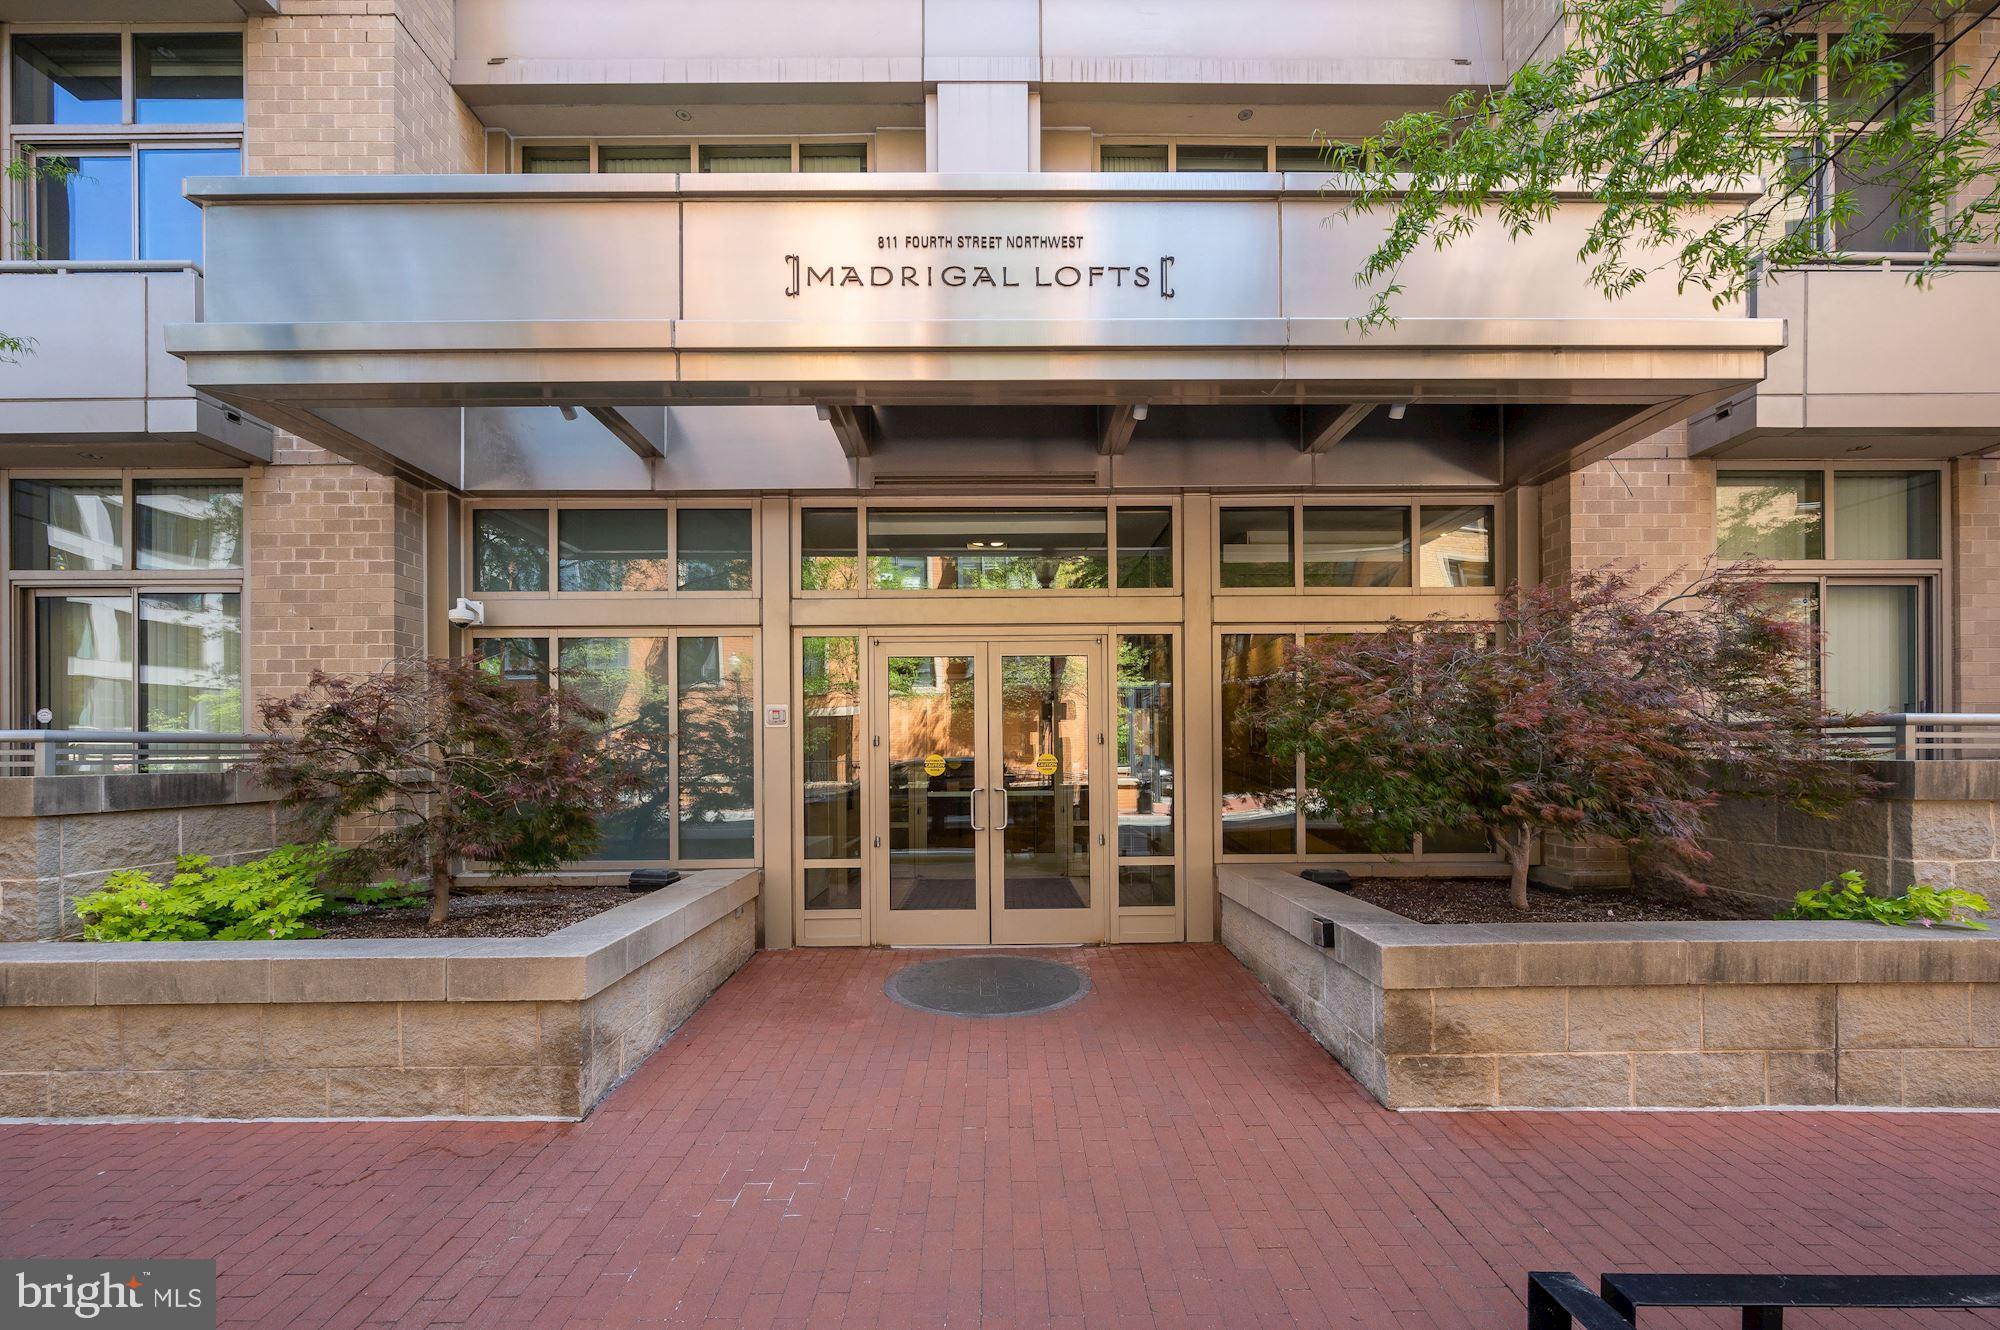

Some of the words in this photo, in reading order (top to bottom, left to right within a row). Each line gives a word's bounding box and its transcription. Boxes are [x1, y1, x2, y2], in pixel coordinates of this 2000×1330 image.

[877, 235, 898, 249] 811
[905, 235, 953, 249] FOURTH
[957, 235, 1003, 249] STREET
[1006, 235, 1084, 249] NORTHWEST
[806, 266, 1020, 288] MADRIGAL
[1035, 266, 1150, 288] LOFTS
